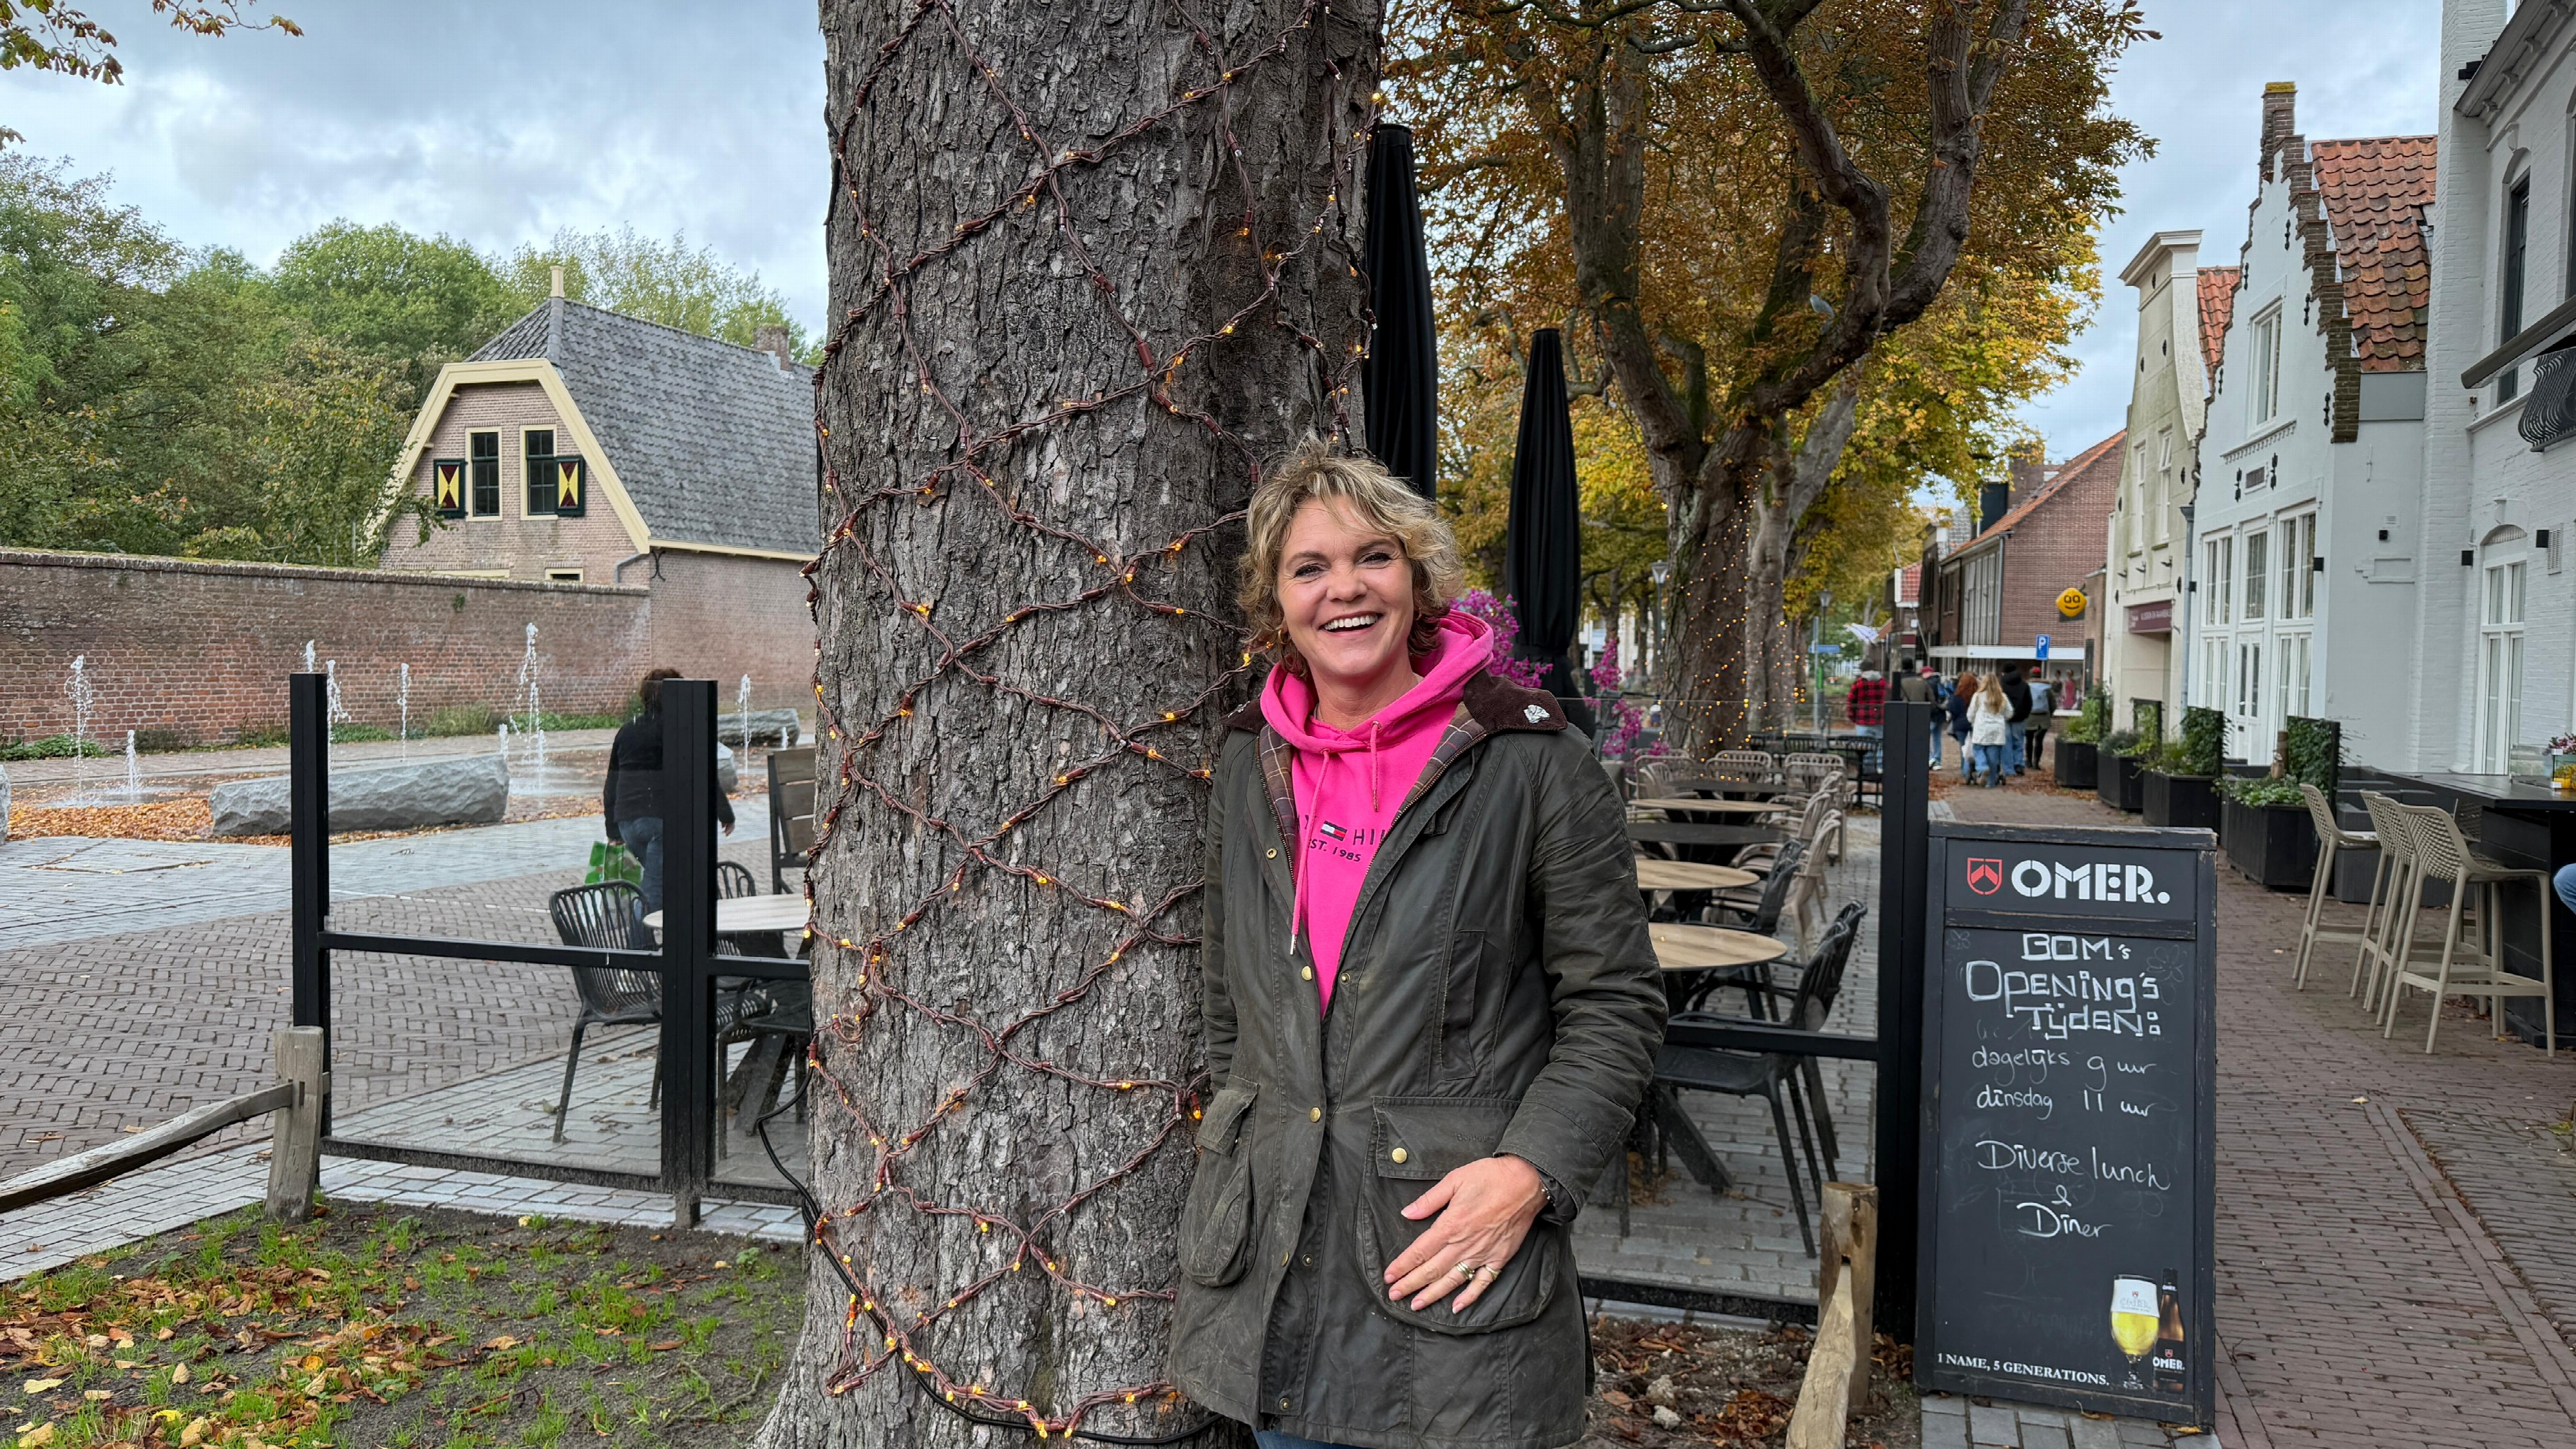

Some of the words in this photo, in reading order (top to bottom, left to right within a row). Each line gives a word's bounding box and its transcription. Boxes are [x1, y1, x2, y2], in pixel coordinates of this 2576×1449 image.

[2038, 636, 2047, 650] P
[1332, 846, 1361, 862] 1985
[2011, 859, 2170, 904] OMER.
[2117, 1061, 2157, 1074] uur
[1976, 1084, 2053, 1121] dinsdag
[2083, 1090, 2103, 1112] 11
[2120, 1101, 2157, 1117] uur
[1975, 1140, 2085, 1176] Diverse
[2092, 1146, 2171, 1191] lunch
[2051, 1184, 2072, 1207] &
[2016, 1202, 2114, 1238] Diner
[1937, 1352, 1943, 1363] 1
[1946, 1353, 1991, 1371] NAME,
[1993, 1360, 2000, 1370] 5
[2003, 1361, 2110, 1386] GENERATIONS.
